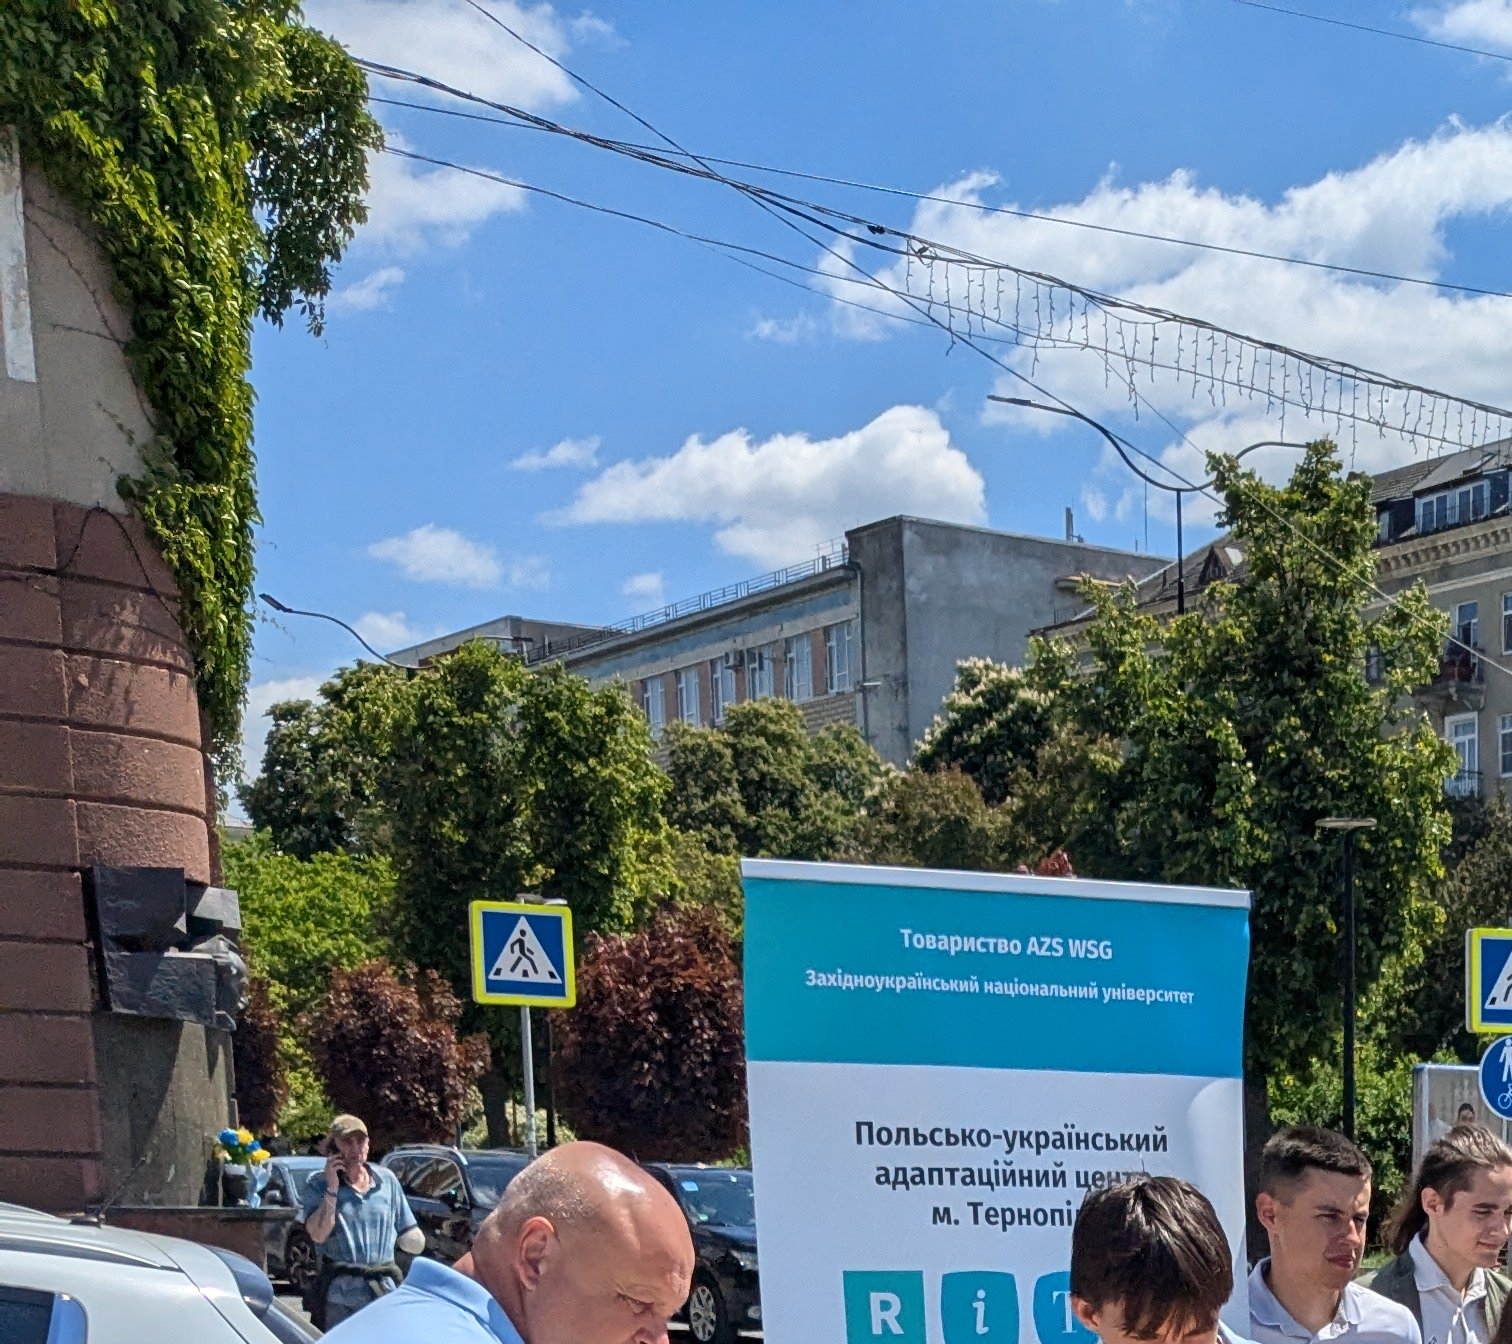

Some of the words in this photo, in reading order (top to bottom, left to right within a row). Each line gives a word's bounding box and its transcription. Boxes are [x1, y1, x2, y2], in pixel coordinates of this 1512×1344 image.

[899, 928, 1022, 956] Товариство
[1026, 935, 1064, 958] AZS
[1067, 938, 1114, 960] WSG
[805, 969, 980, 995] Західноукраїнський
[983, 976, 1099, 1001] національний
[1101, 984, 1195, 1005] університет
[855, 1120, 1169, 1156] Польсько-український
[875, 1159, 1068, 1191] адаптаційний
[1075, 1169, 1149, 1193] цент
[931, 1204, 960, 1226] м.
[967, 1200, 1083, 1233] Тернопі
